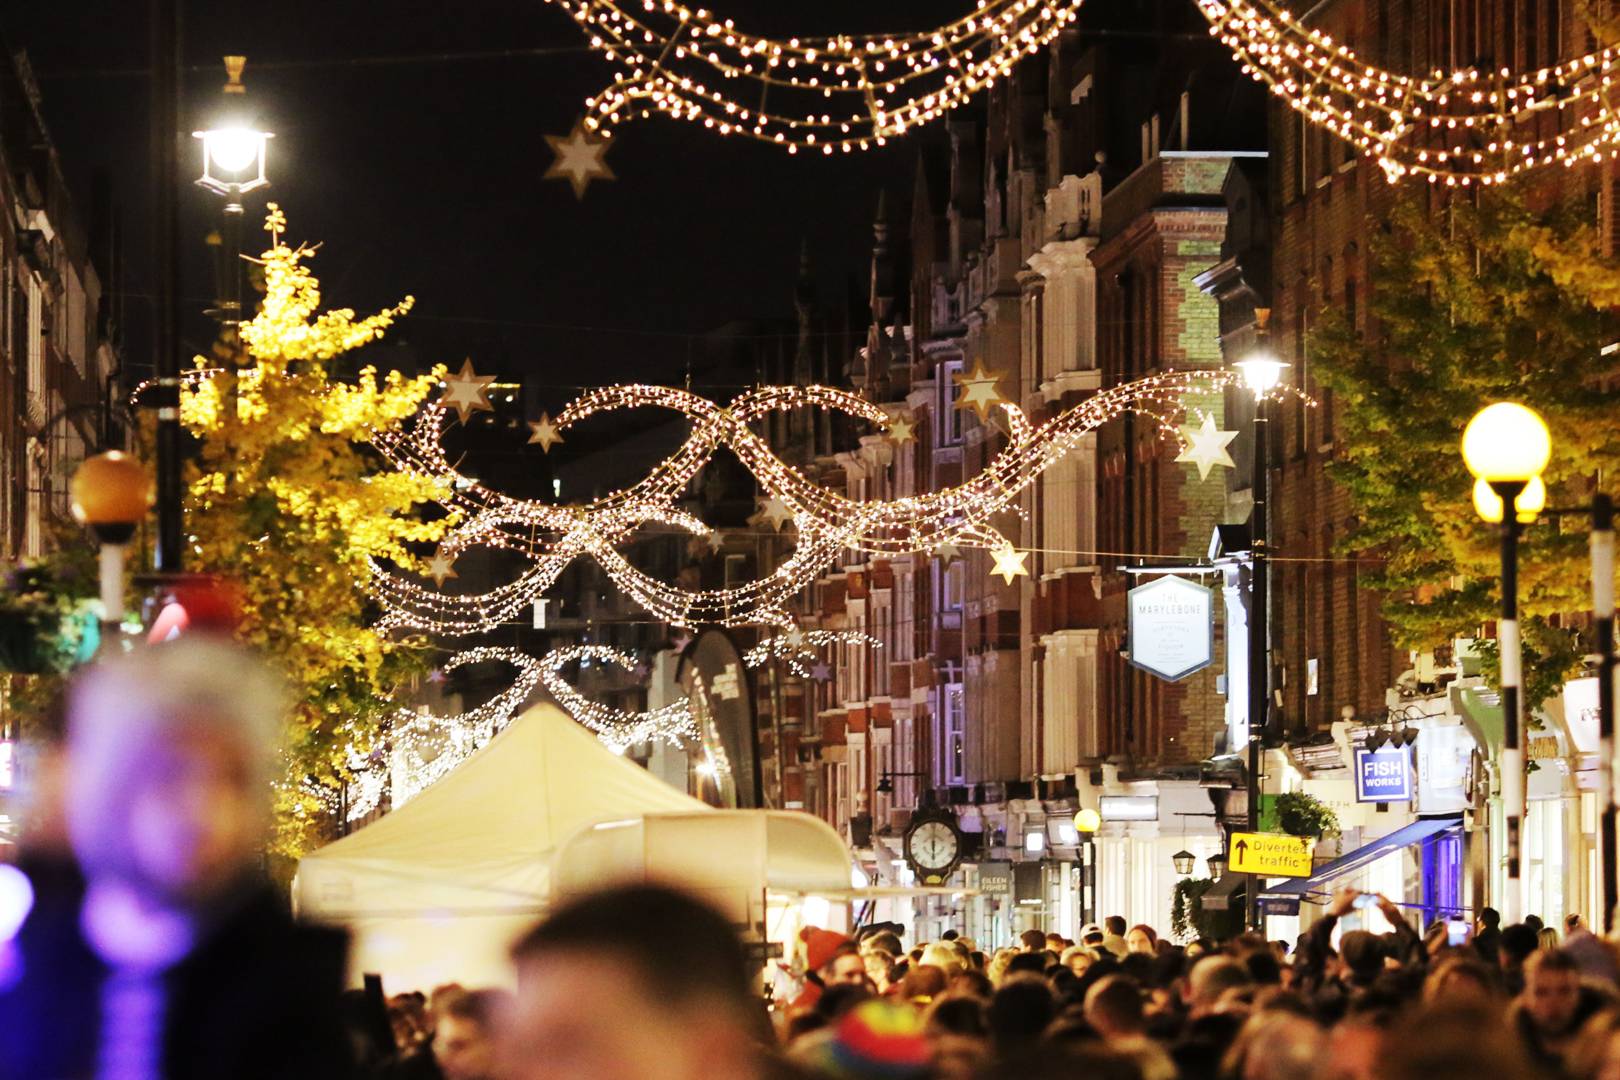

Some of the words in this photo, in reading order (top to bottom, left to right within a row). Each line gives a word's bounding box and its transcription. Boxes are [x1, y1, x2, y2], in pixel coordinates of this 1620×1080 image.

[1162, 592, 1178, 603] THE
[1138, 604, 1201, 614] MARYLEBONE
[1364, 761, 1402, 777] FISH
[1365, 777, 1402, 788] WORKS
[1259, 855, 1299, 868] traffic
